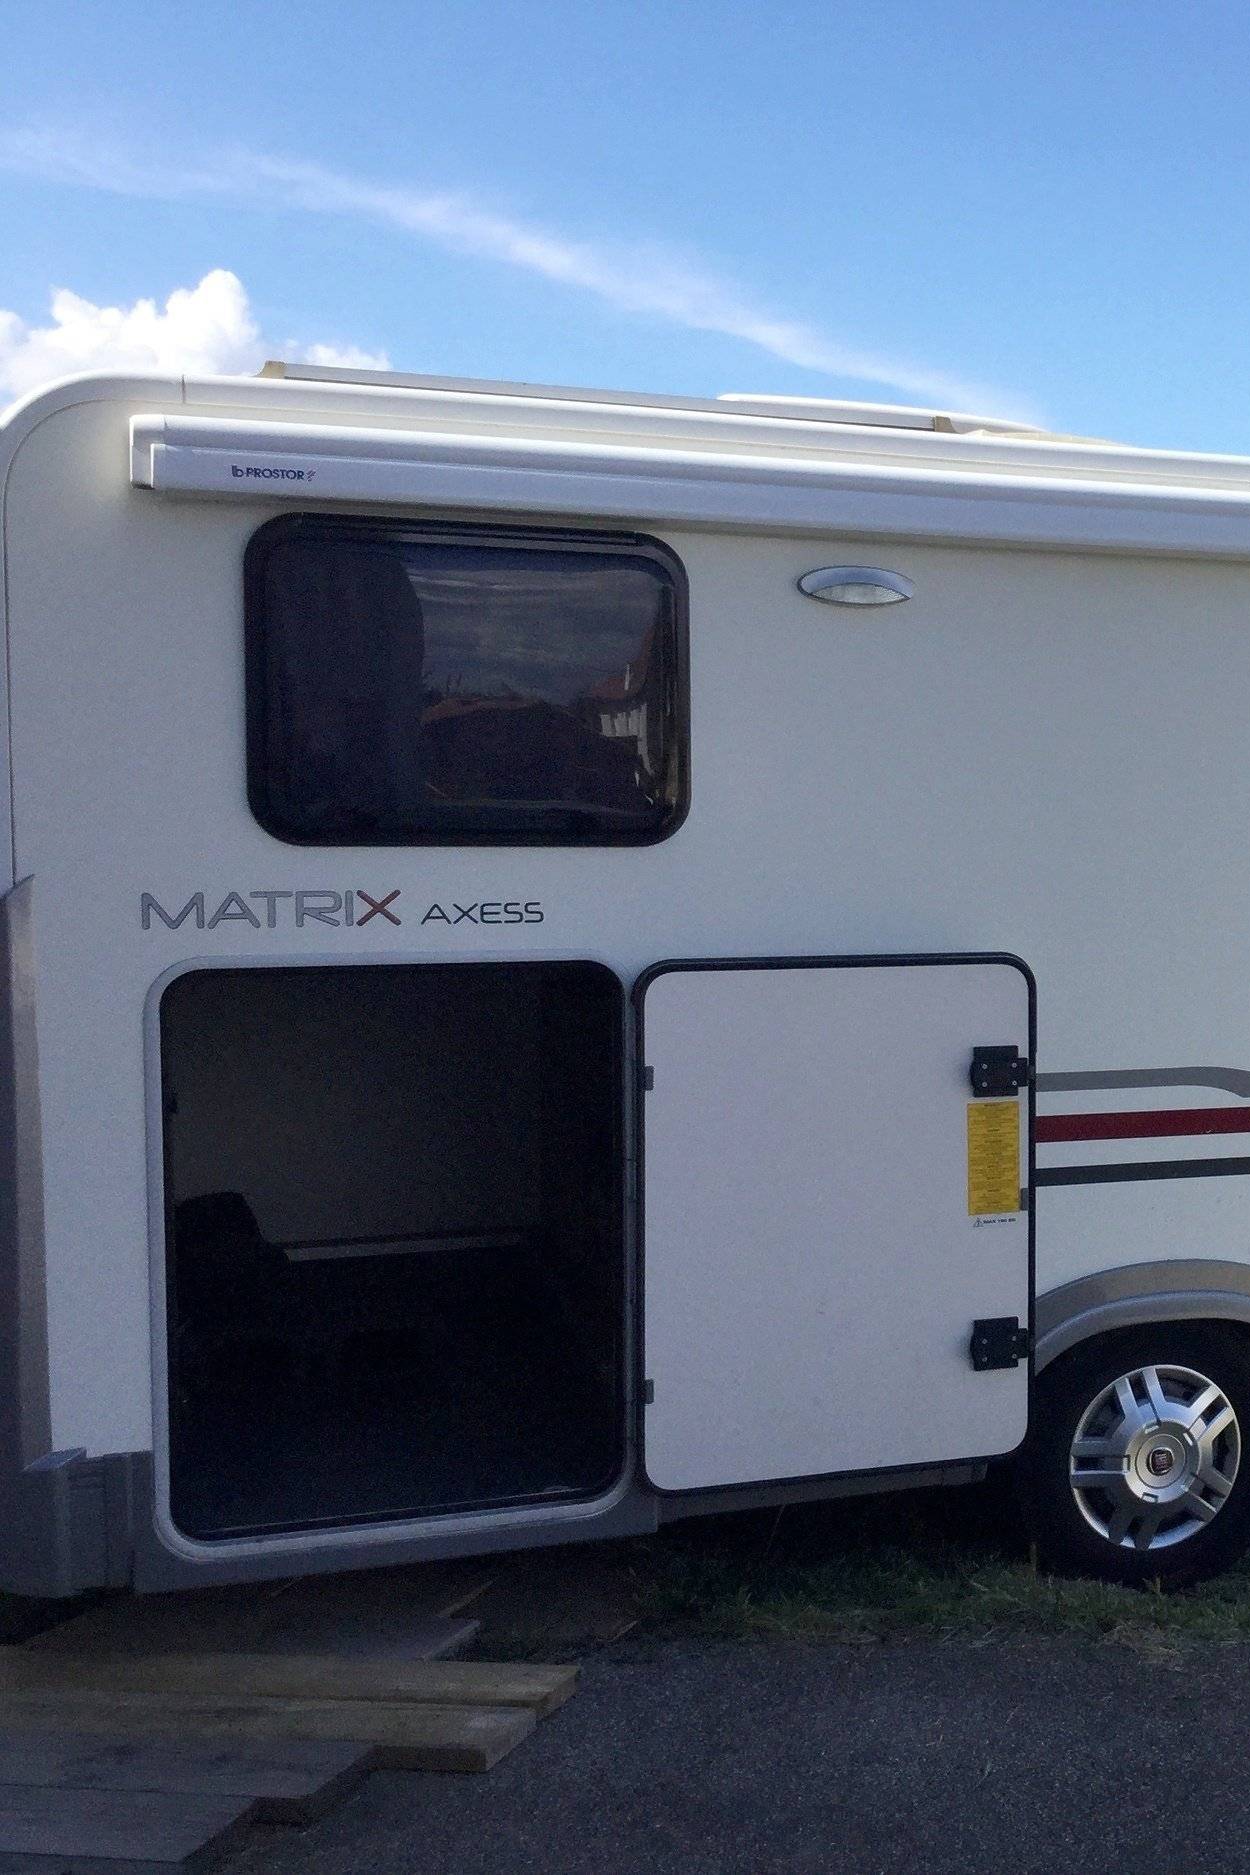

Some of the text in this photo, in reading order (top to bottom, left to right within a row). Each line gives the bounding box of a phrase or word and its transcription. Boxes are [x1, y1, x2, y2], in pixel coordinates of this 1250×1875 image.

[246, 467, 304, 480] PROSTOR
[141, 889, 545, 930] MATRIX AXESS
